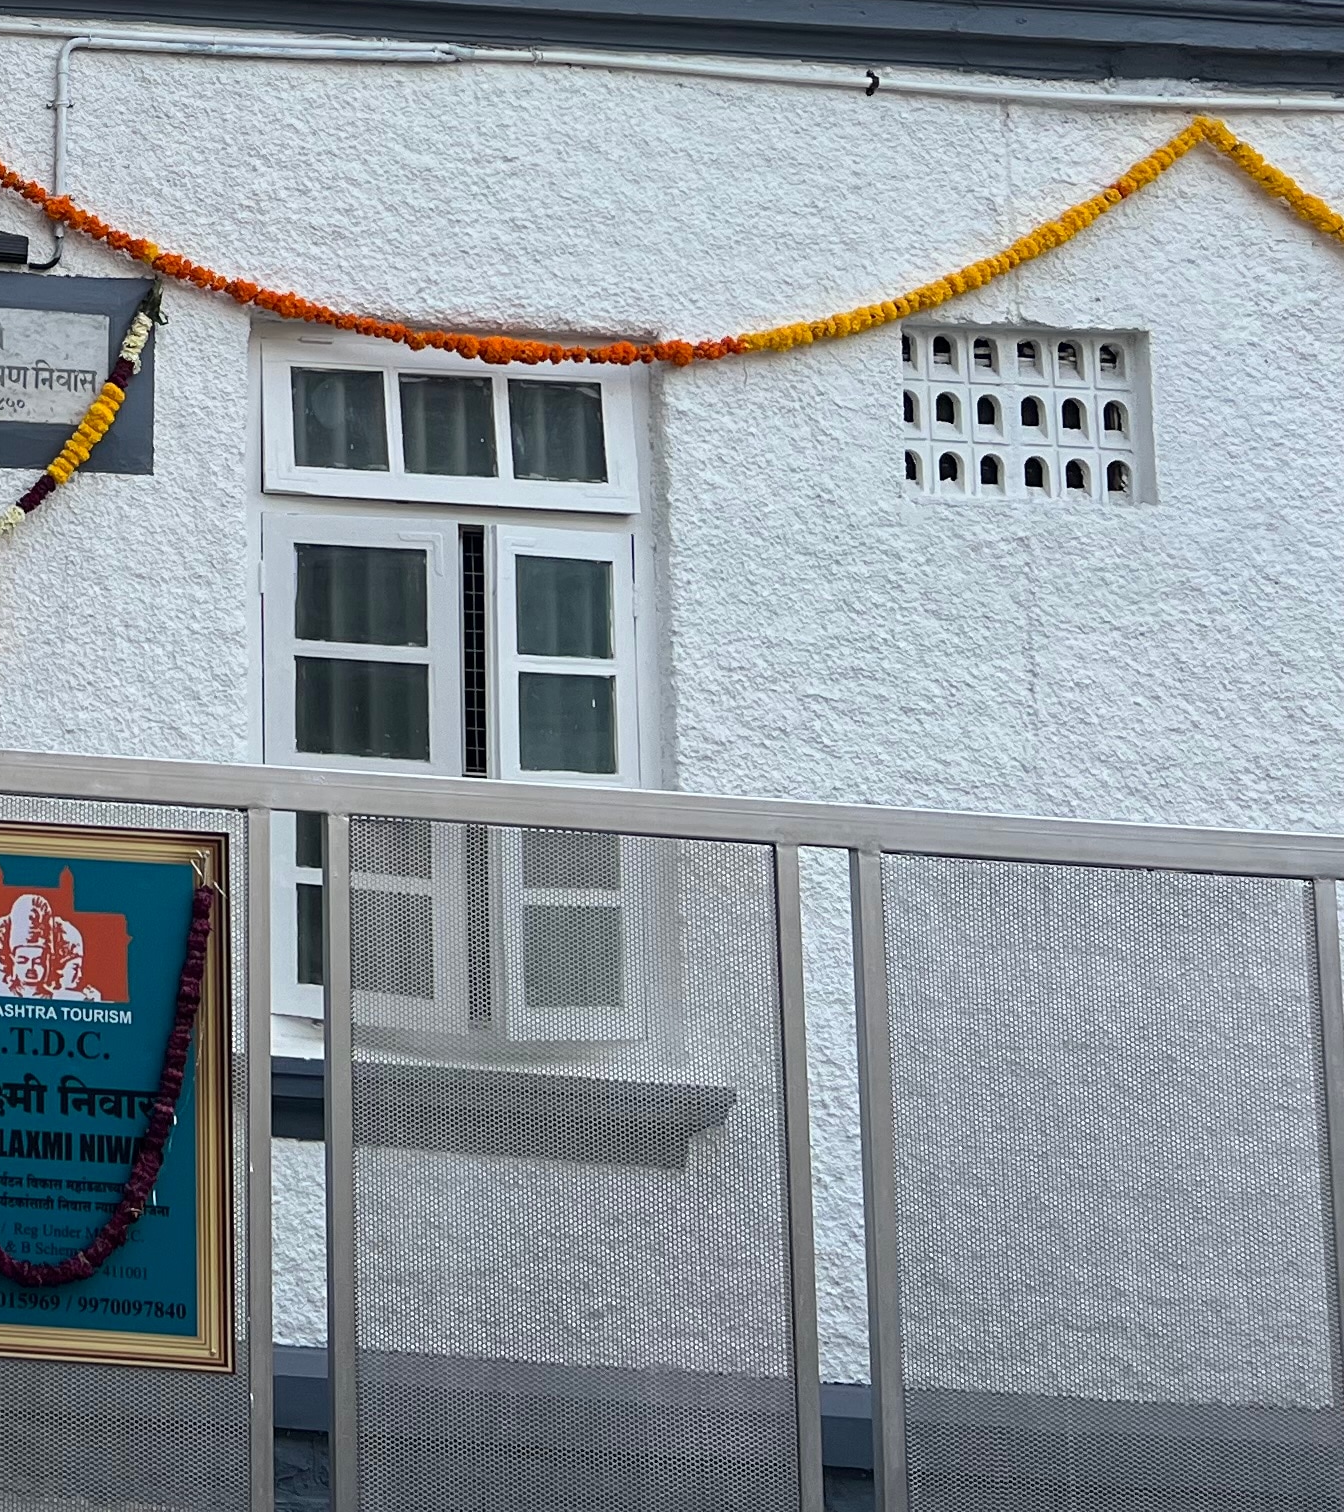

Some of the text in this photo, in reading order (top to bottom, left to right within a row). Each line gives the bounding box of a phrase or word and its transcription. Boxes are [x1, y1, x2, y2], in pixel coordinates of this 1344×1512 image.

[32, 360, 98, 393] निवास
[61, 1006, 133, 1025] TOURISM
[14, 1222, 39, 1240] Reg
[42, 1224, 82, 1240] Under
[102, 1264, 148, 1281] 411001
[78, 1295, 187, 1320] 9970097840
